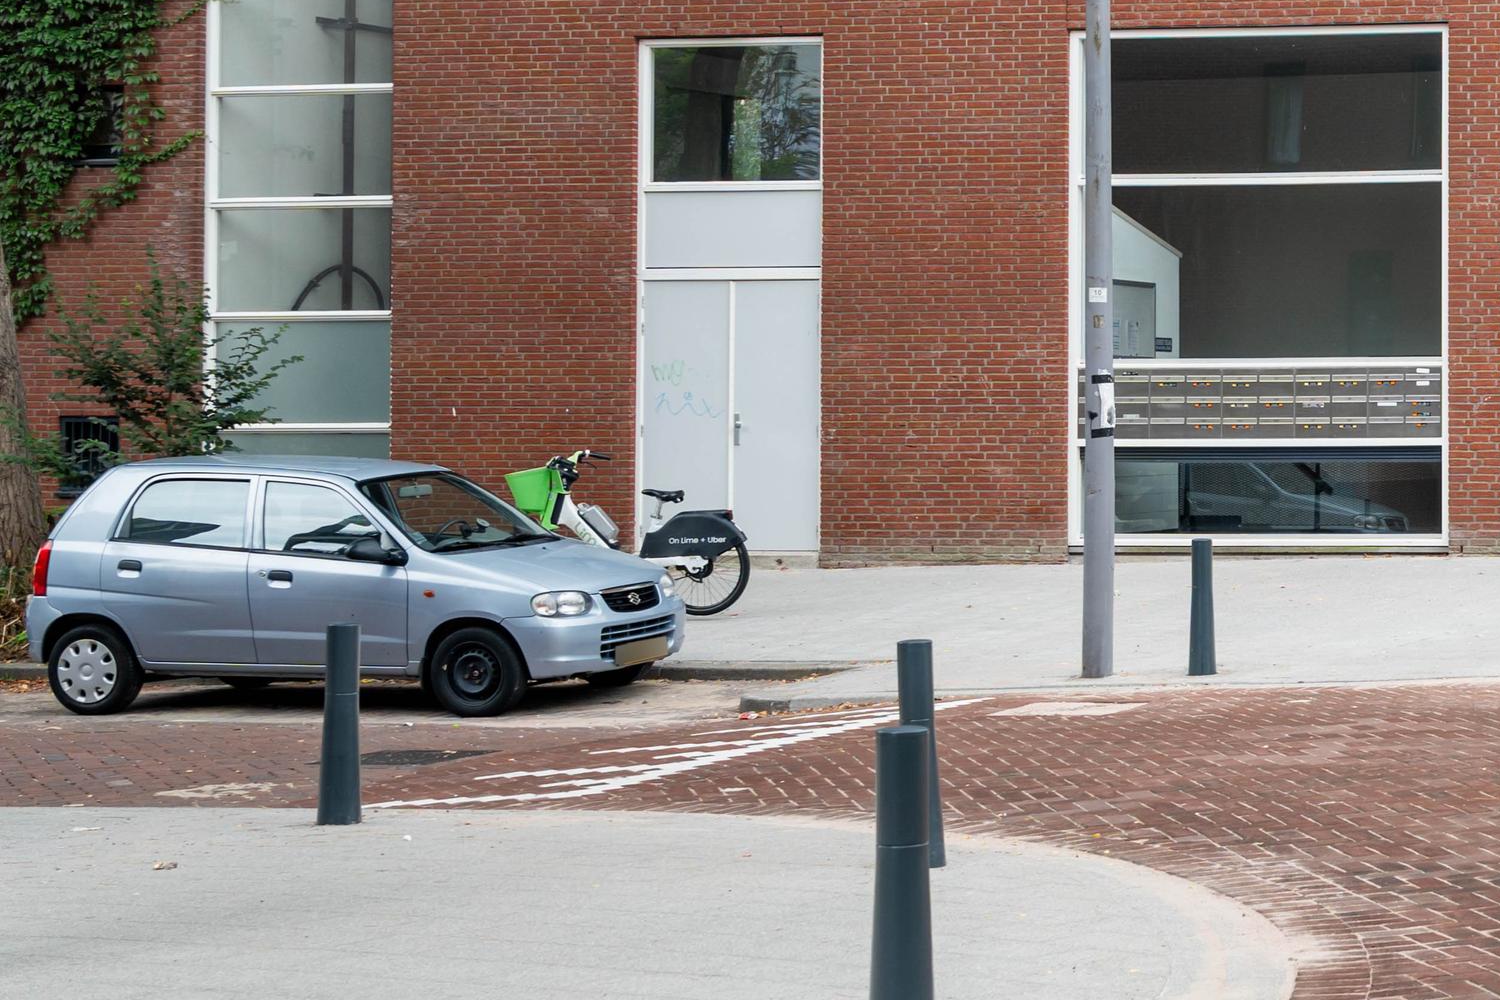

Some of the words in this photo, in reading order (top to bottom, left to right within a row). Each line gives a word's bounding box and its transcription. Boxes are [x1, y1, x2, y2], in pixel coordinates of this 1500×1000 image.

[574, 521, 597, 546] Lim
[668, 537, 680, 545] On
[680, 536, 699, 544] Lime
[707, 536, 727, 544] Uber
